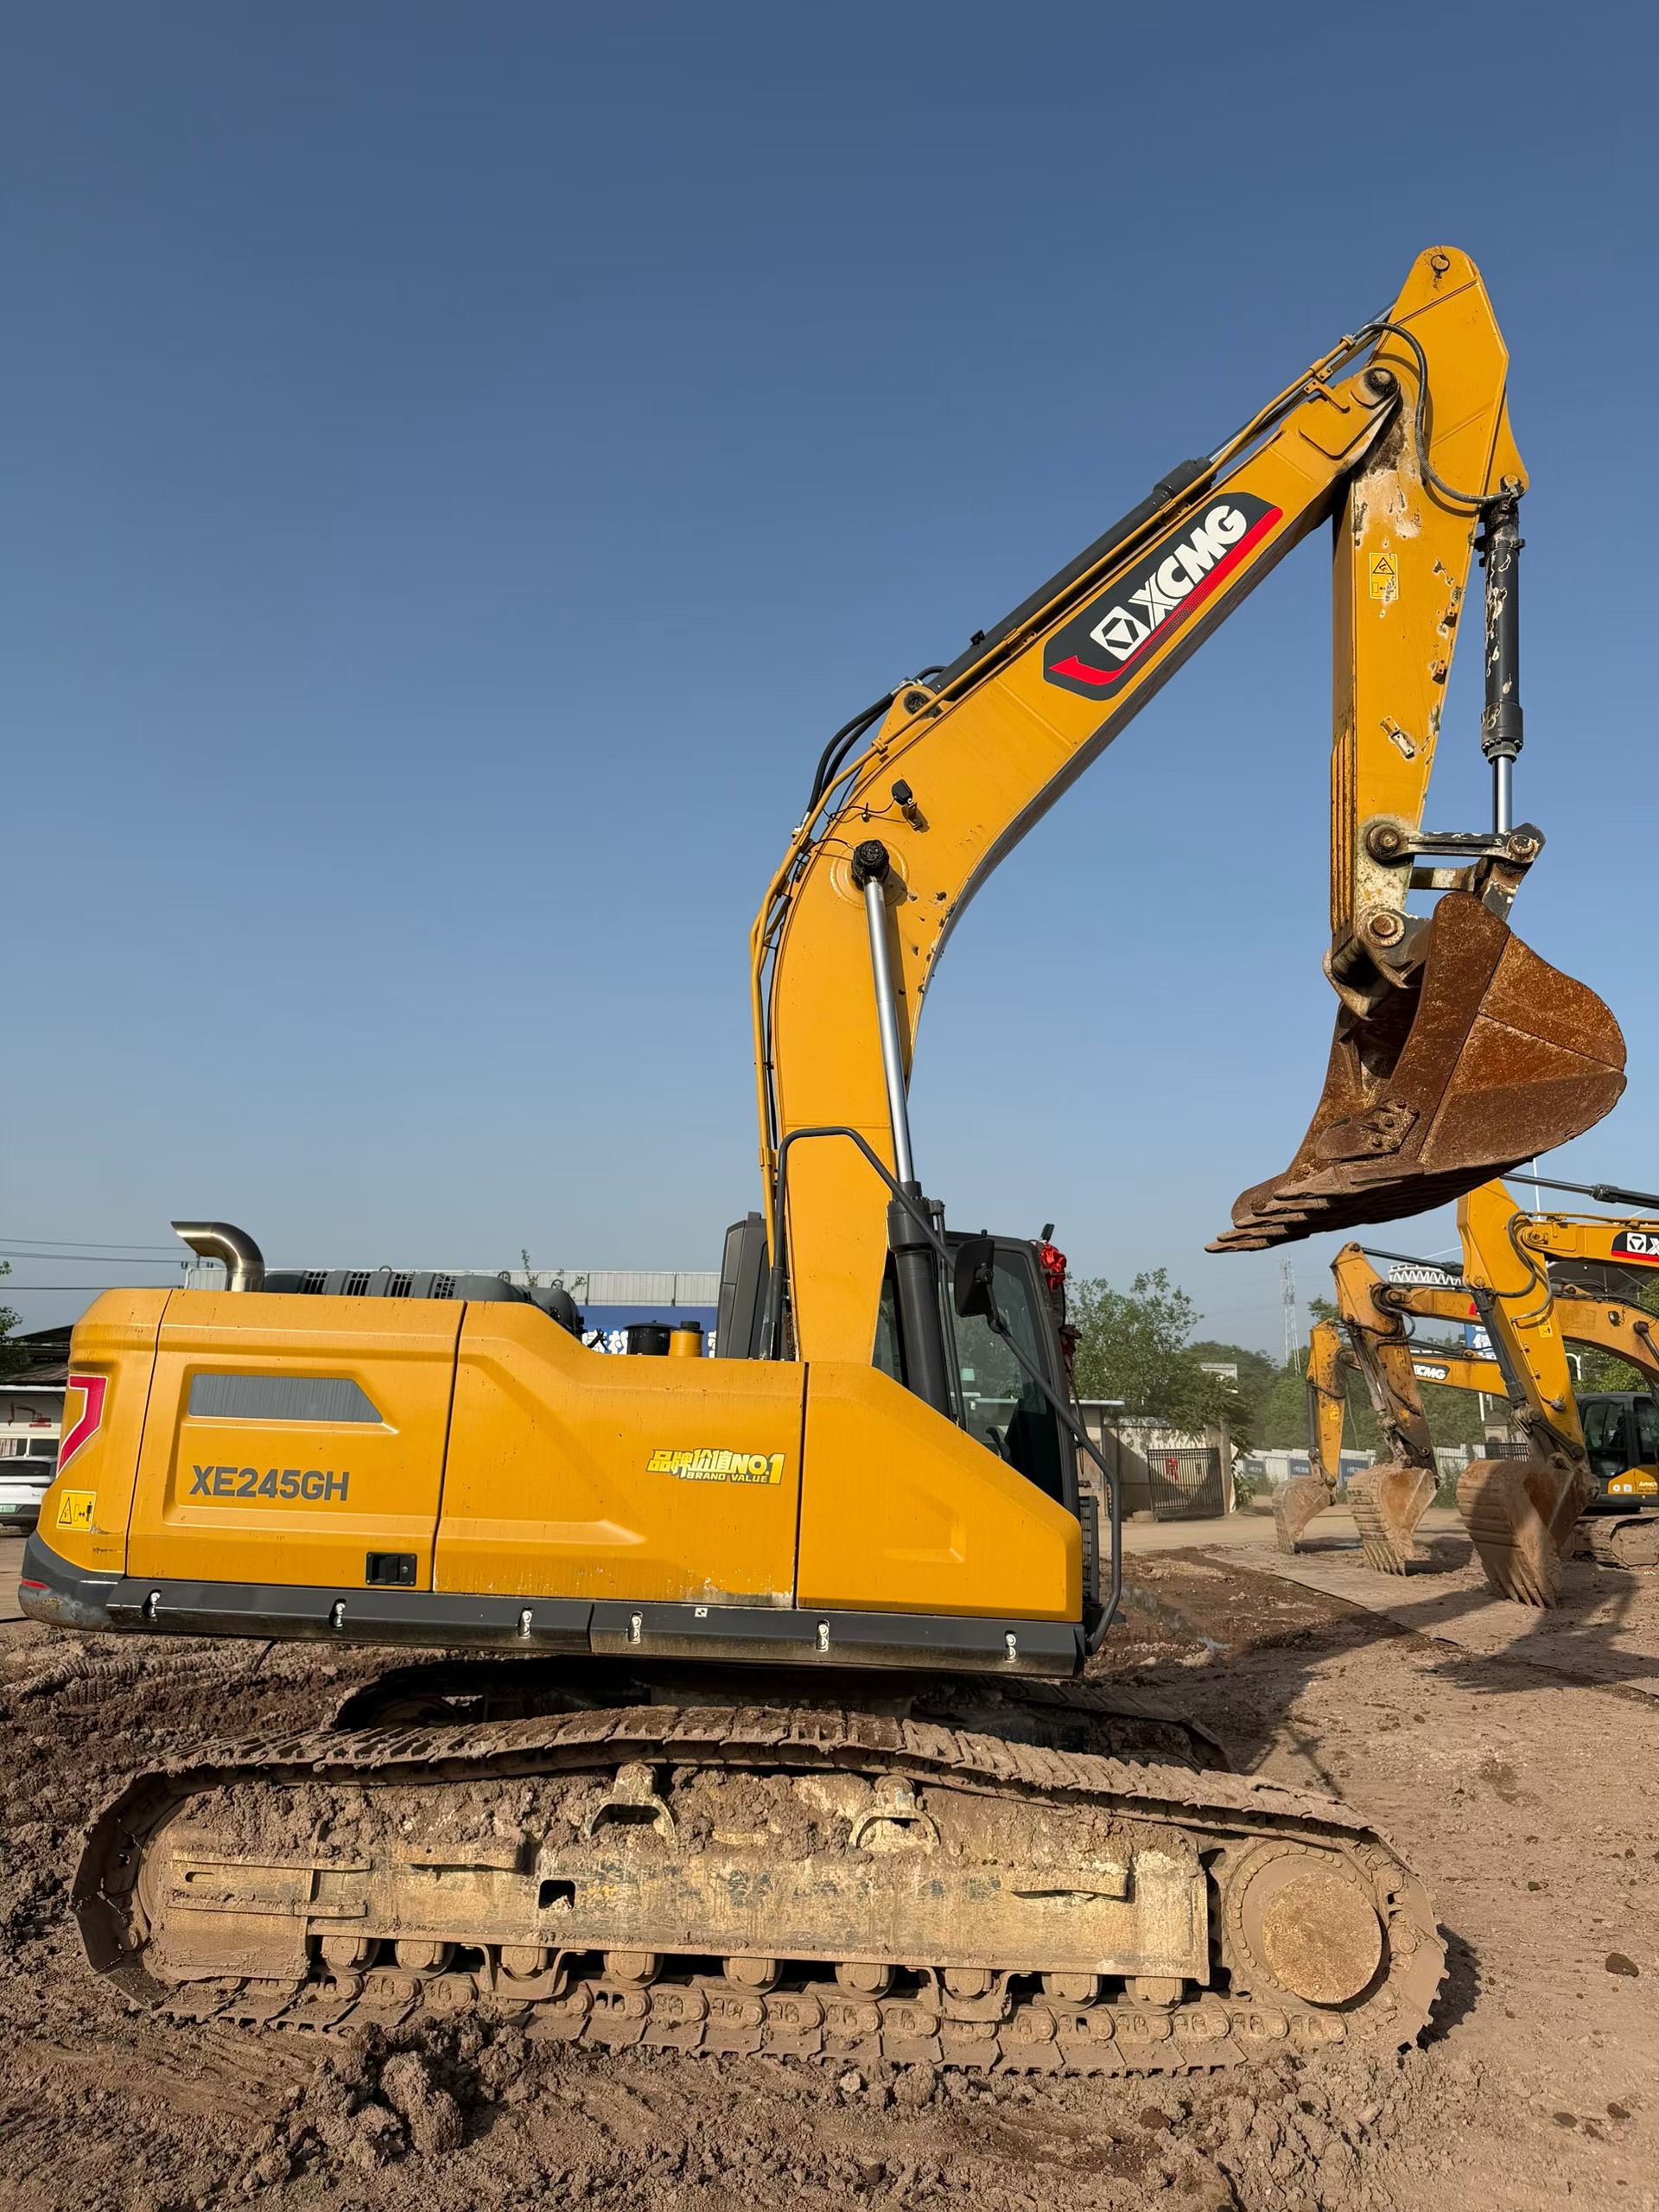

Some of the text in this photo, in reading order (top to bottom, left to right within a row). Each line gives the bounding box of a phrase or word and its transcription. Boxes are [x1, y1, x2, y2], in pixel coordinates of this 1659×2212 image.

[1127, 504, 1248, 632] XCMG
[189, 1465, 350, 1502] XE245GH
[686, 1471, 769, 1484] BRAND VALUE
